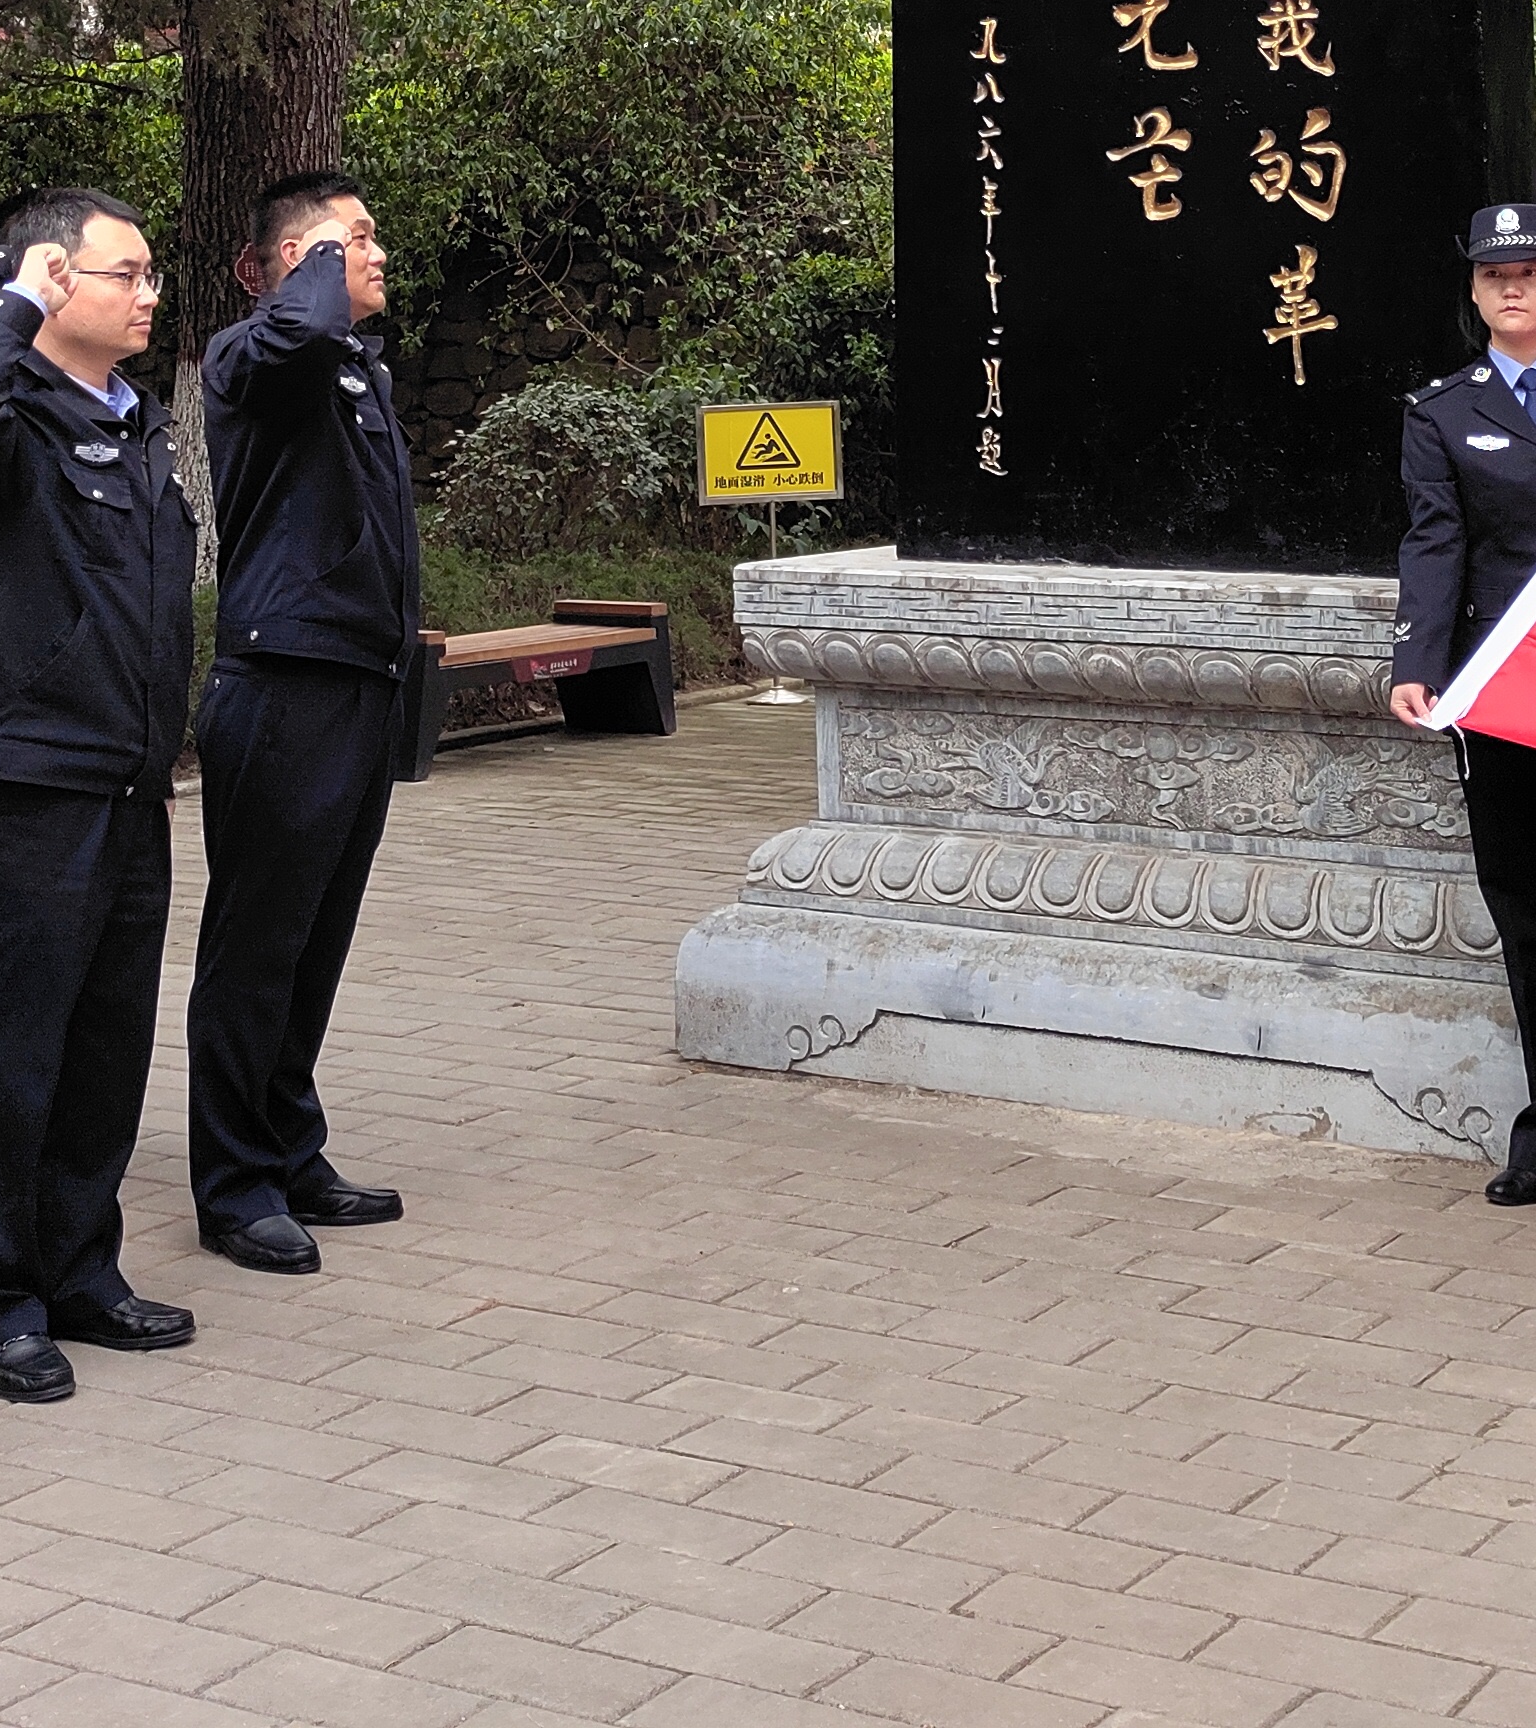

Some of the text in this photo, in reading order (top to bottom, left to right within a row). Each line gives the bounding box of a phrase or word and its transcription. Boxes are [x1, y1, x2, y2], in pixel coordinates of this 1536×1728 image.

[714, 471, 824, 489] 地面湿滑 小心跌倒
